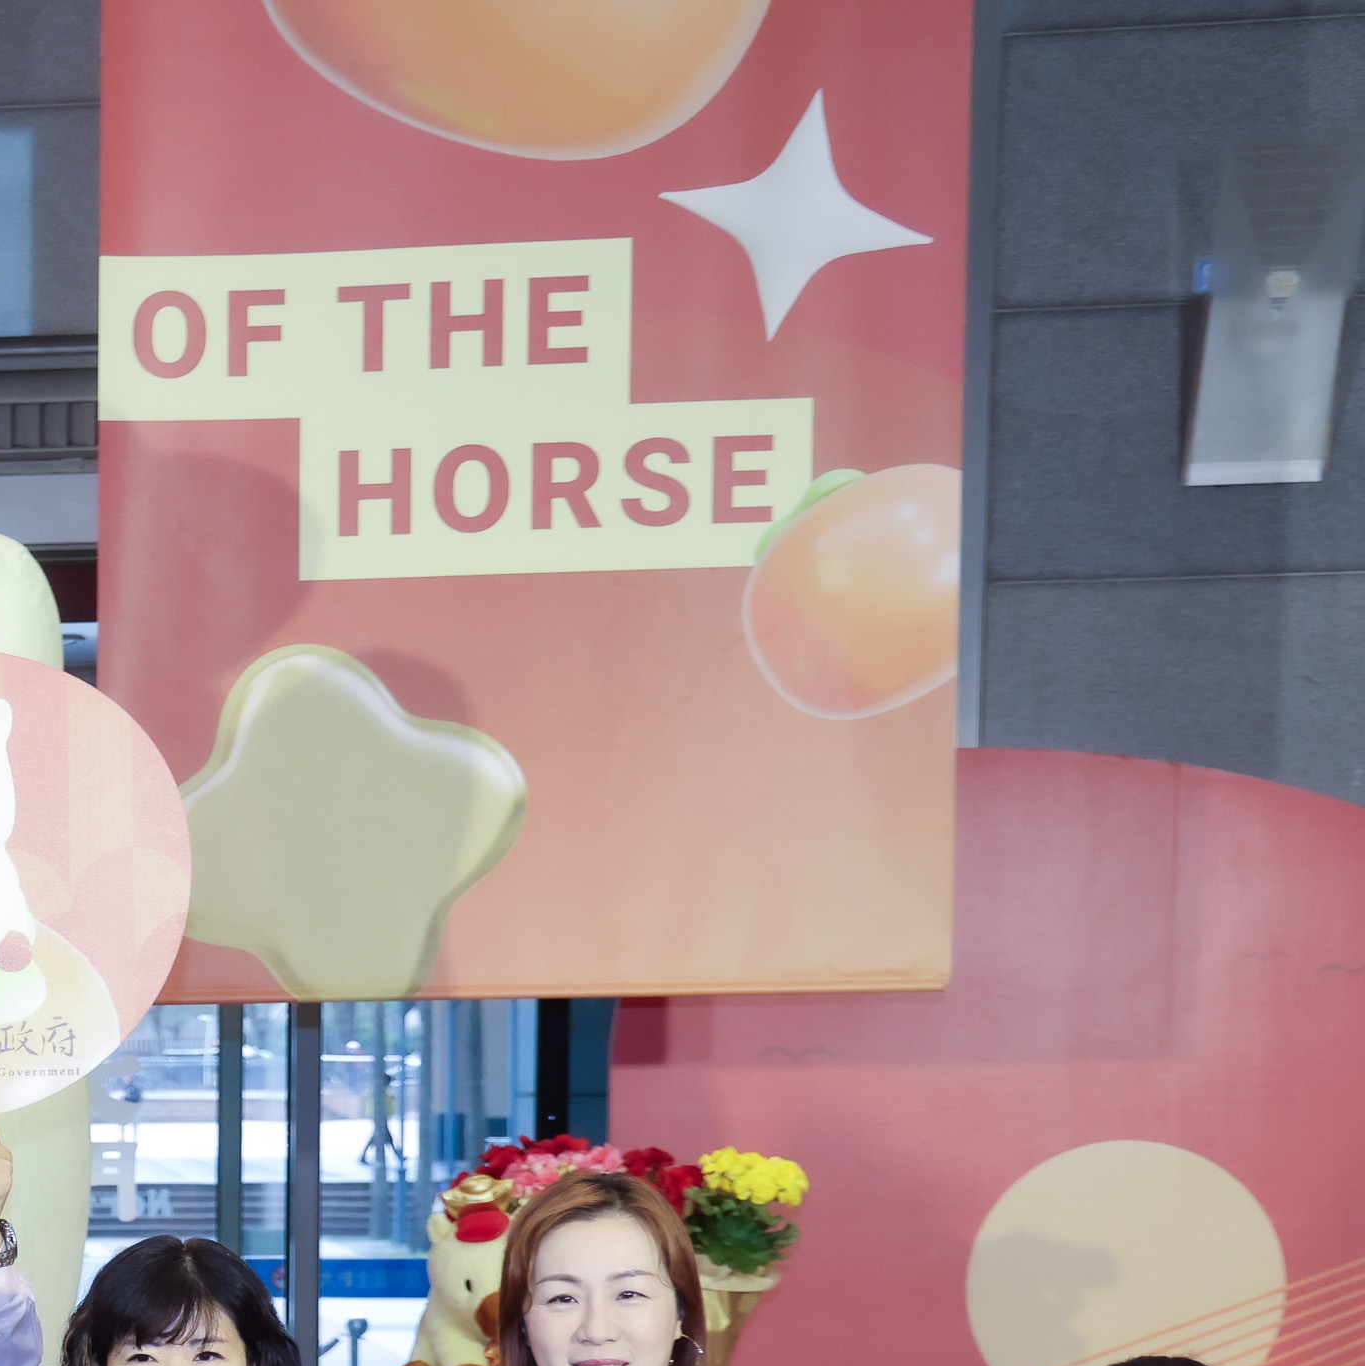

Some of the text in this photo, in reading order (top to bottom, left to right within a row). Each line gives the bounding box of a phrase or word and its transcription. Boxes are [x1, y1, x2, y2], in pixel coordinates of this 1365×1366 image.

[131, 274, 591, 381] OF THE
[337, 433, 776, 537] HORSE
